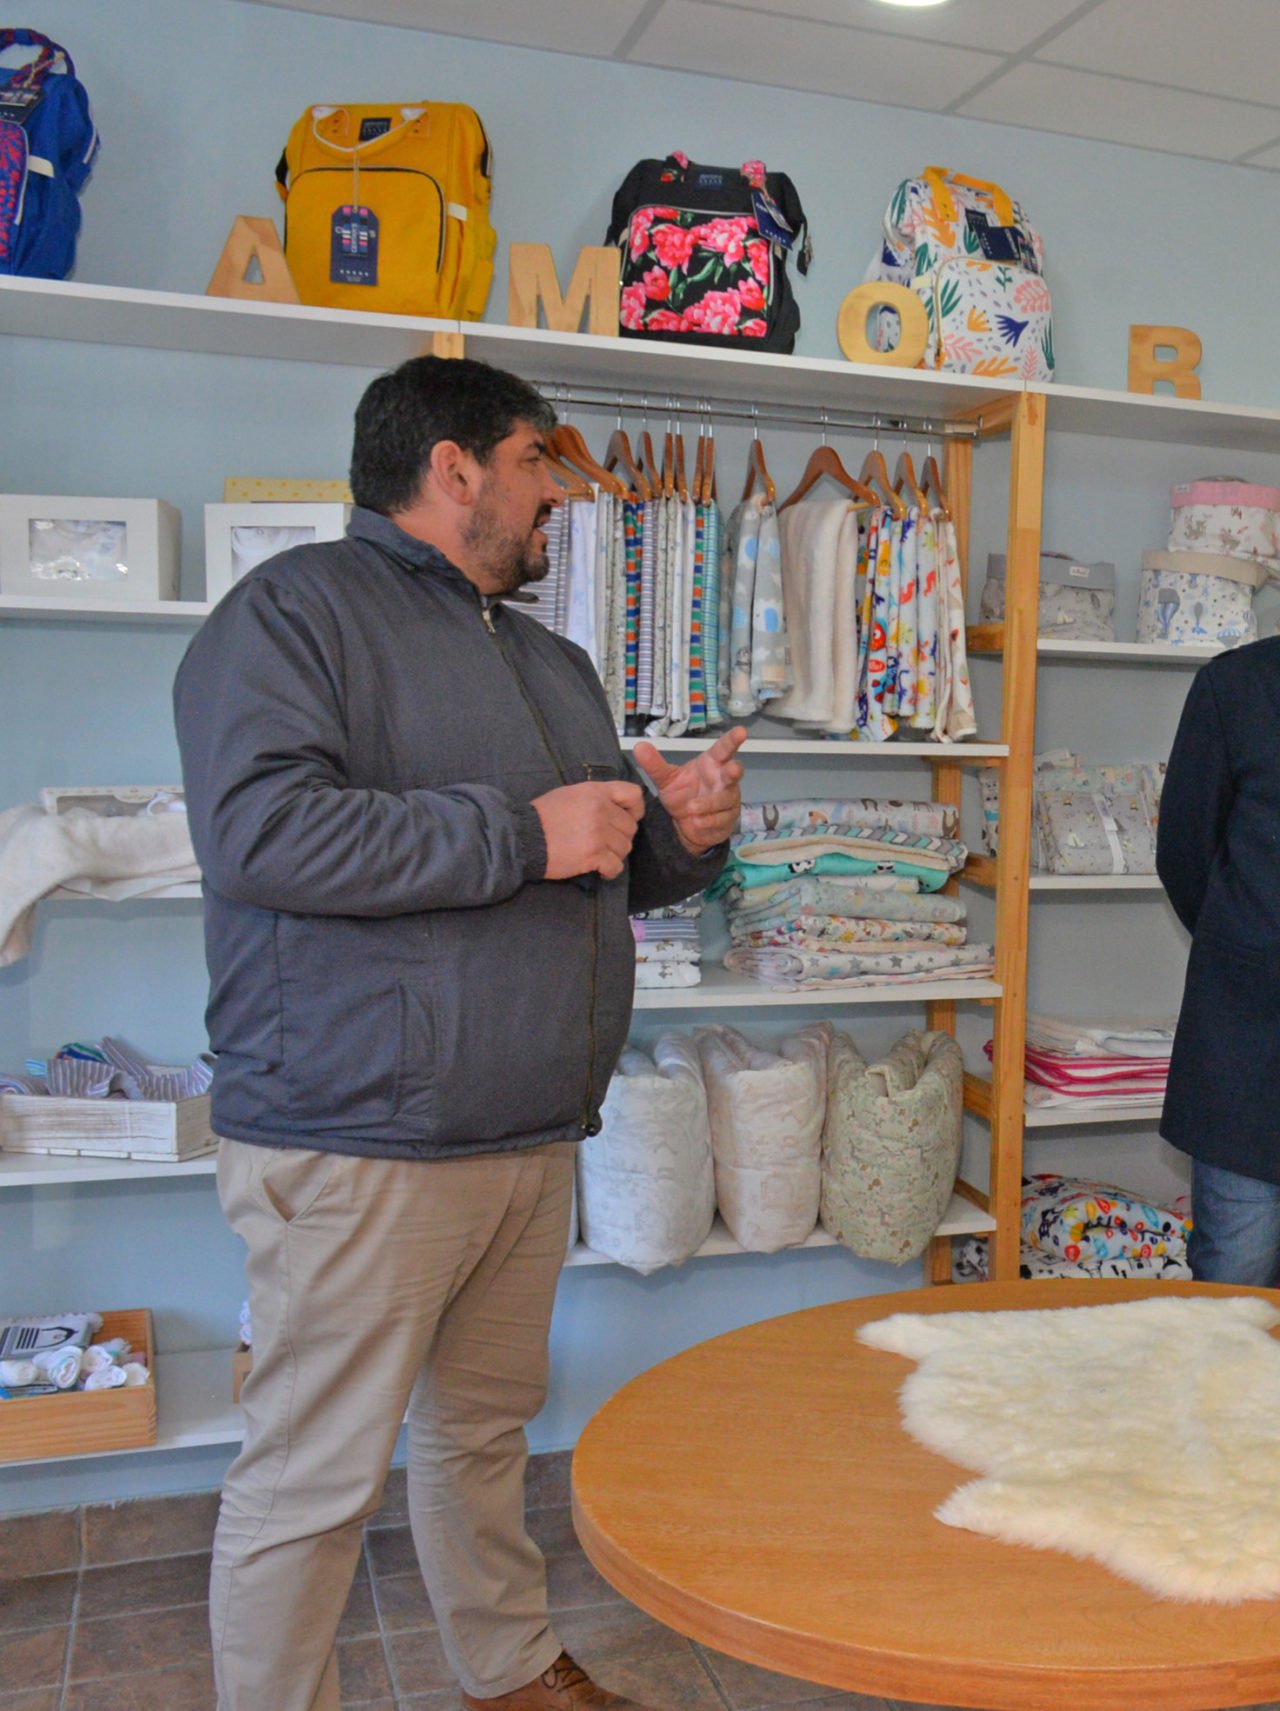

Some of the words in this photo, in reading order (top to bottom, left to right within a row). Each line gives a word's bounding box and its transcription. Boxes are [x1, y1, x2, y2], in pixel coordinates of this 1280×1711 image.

[206, 214, 300, 305] A
[508, 243, 621, 338] M
[836, 281, 930, 368] O
[1127, 324, 1203, 400] R
